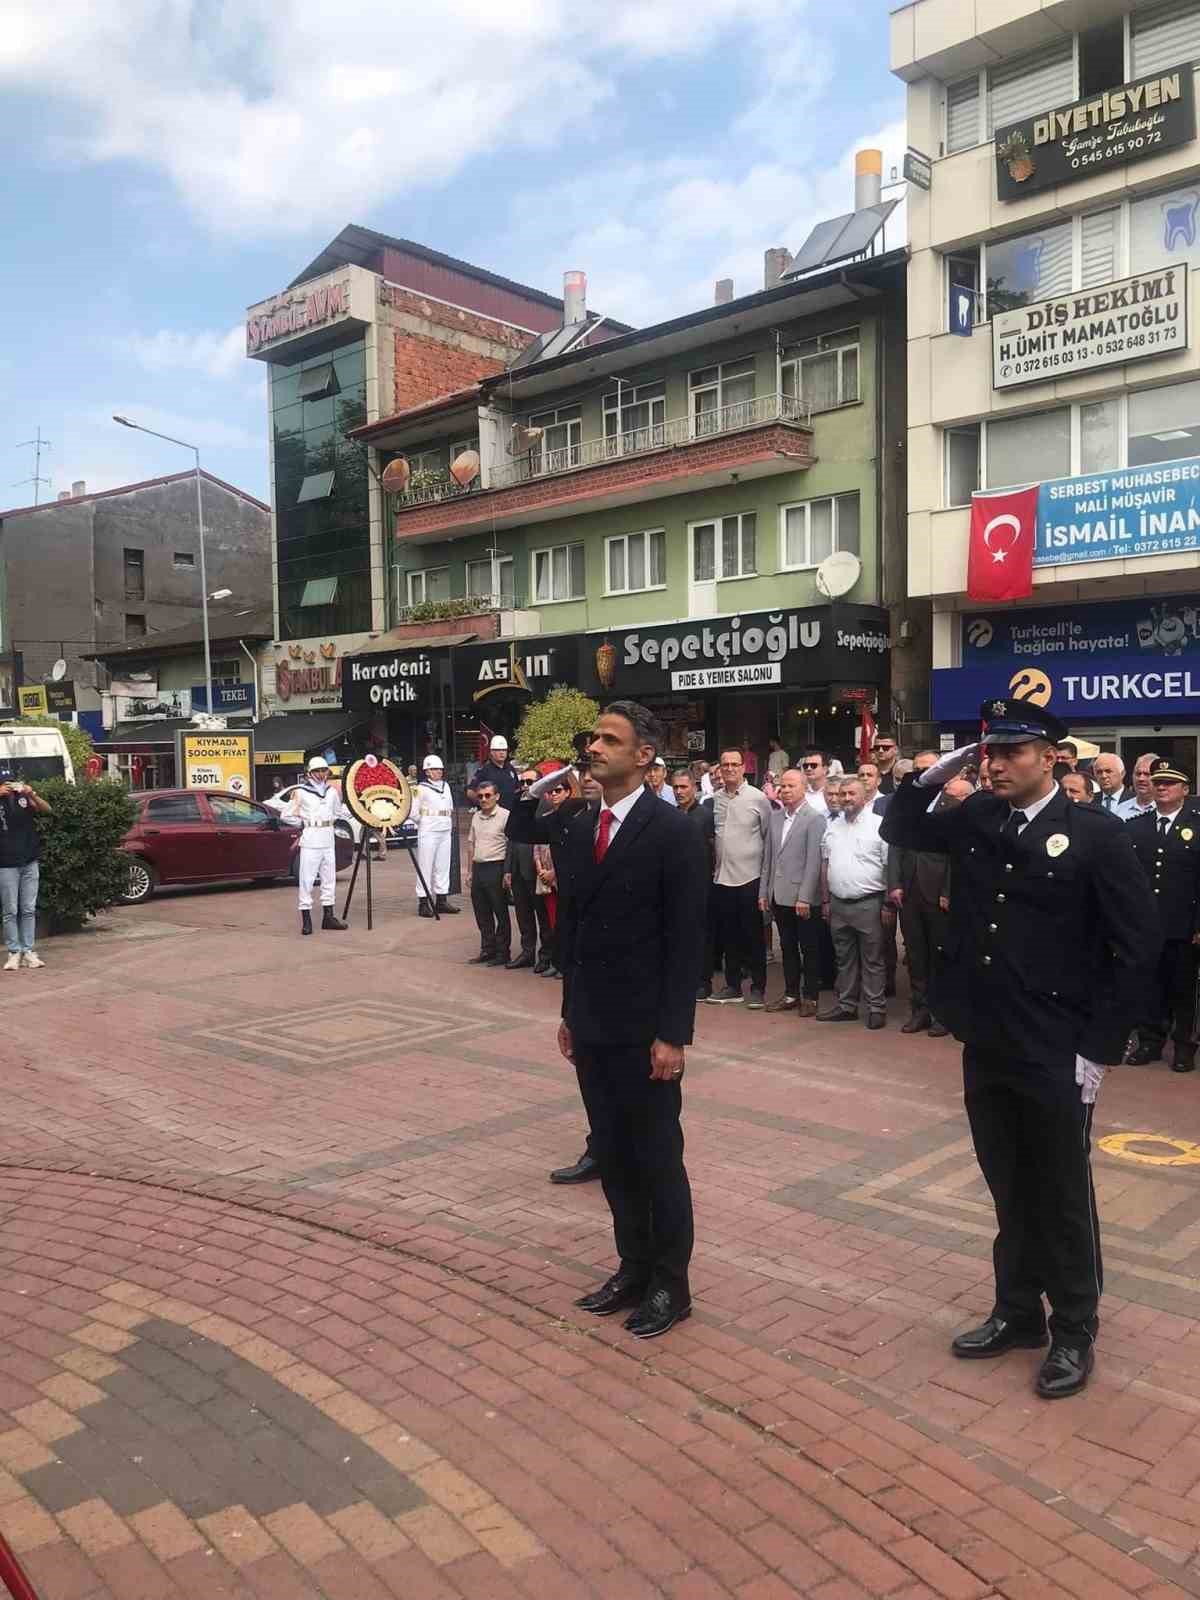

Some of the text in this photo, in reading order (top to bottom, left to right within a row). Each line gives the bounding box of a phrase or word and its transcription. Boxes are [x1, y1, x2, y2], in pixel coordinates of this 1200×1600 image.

[1033, 73, 1180, 146] DİYETİSYEN
[1062, 135, 1103, 157] Gamze
[1071, 130, 1161, 168] 0 545 615 90 72
[1026, 270, 1176, 331] DİŞ HEKİMİ
[999, 302, 1179, 362] H.ÜMİT MAMATOĞLU
[1015, 363, 1022, 375] 0
[1024, 359, 1040, 373] 372
[1042, 355, 1060, 368] 615
[1062, 350, 1073, 363] 03
[1077, 347, 1088, 360] 13
[1097, 345, 1103, 356] 0
[1106, 339, 1123, 354] 532
[1127, 334, 1145, 349] 648
[1148, 331, 1160, 344] 31
[1164, 326, 1177, 340] 73
[1050, 478, 1107, 500] SERBEST
[1075, 486, 1176, 514] MALİ MÜŞAVİR
[1045, 513, 1132, 548] İSMAİL
[1113, 543, 1132, 555] Tel:
[623, 613, 820, 670] Sepetçioğlu
[1013, 638, 1064, 656] bağlan
[1068, 633, 1129, 653] hayata!
[352, 653, 431, 681] Karadeniz
[698, 672, 705, 686] &
[706, 670, 735, 685] YEMEK
[737, 667, 772, 682] SALONU
[220, 689, 248, 702] TEKEL
[370, 681, 416, 707] Optik
[1062, 671, 1200, 701] TURKCEL
[196, 738, 239, 747] KIYMADA
[263, 753, 280, 763] AVM
[191, 774, 220, 784] 390TL
